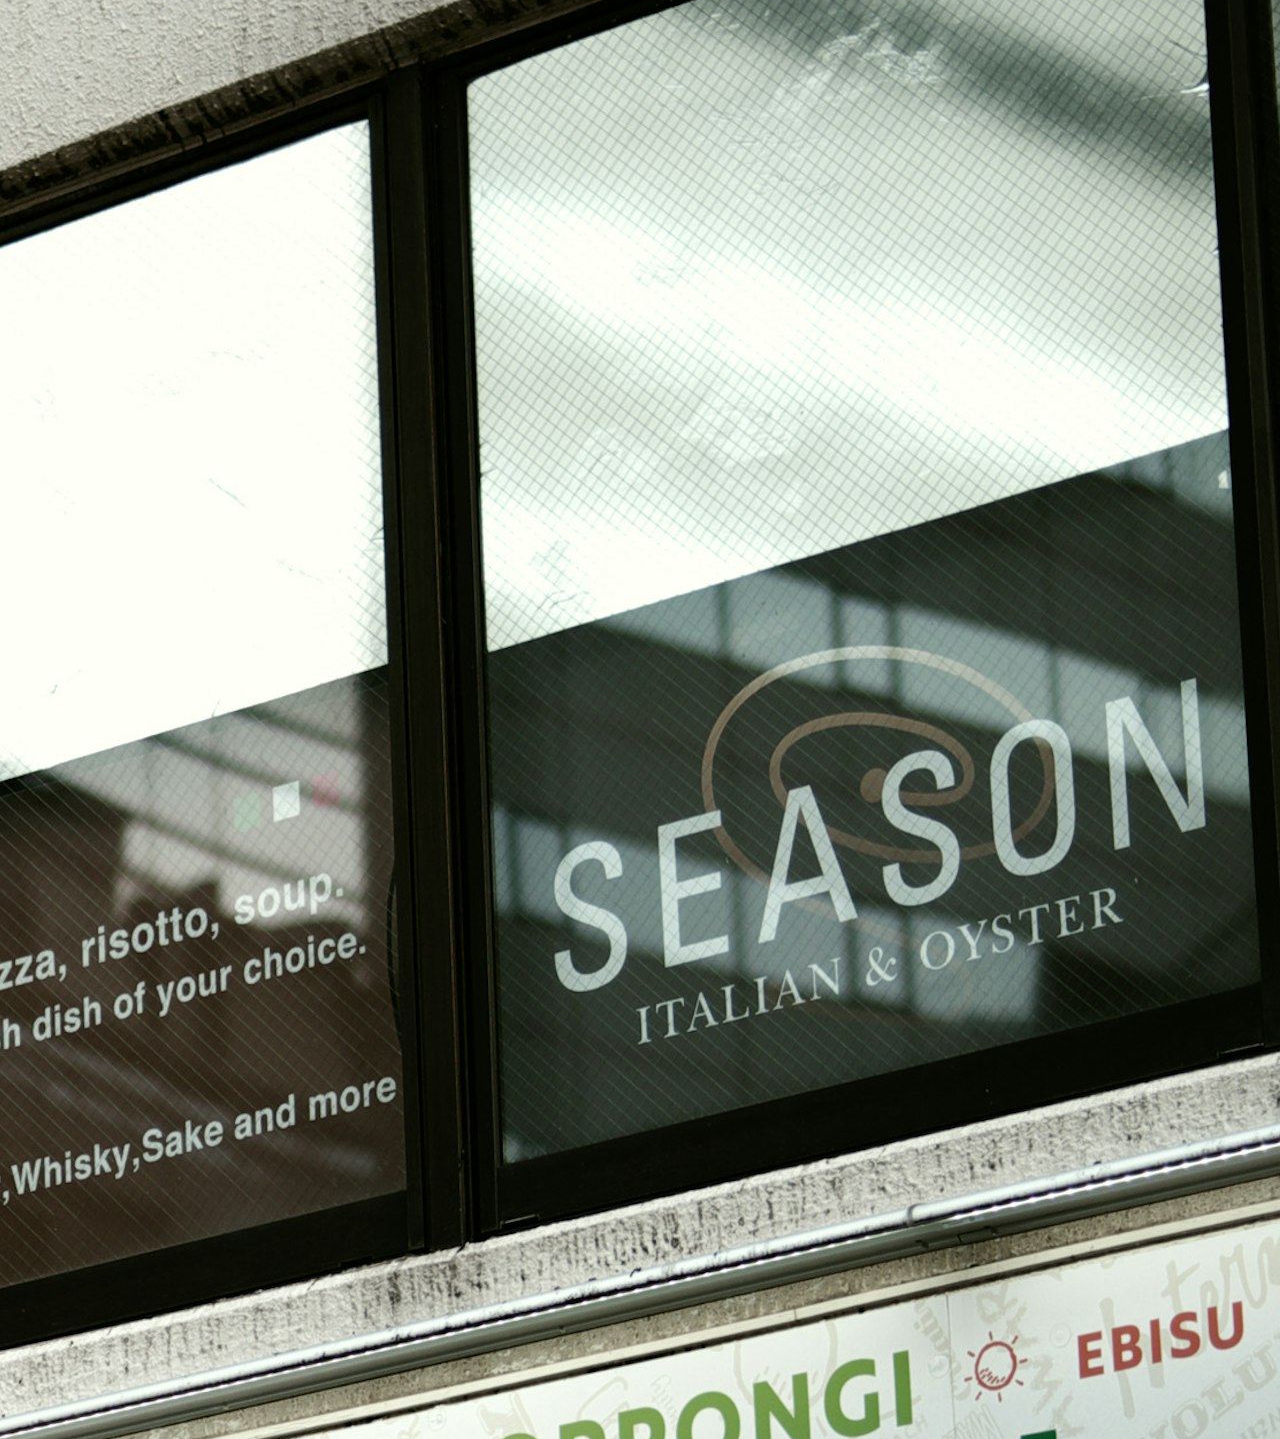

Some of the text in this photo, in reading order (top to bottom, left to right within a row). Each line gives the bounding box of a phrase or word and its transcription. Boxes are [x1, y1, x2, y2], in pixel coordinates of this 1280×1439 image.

[553, 677, 1208, 994] SEASON
[81, 906, 221, 969] risotto,
[233, 870, 346, 925] soup.
[636, 887, 1126, 1046] ITALIAN & OYSTER
[32, 997, 102, 1042] dish
[113, 986, 147, 1022] of
[156, 964, 232, 1017] your
[243, 931, 368, 986] choice.
[233, 1095, 297, 1141] and
[308, 1073, 398, 1124] more
[1076, 1300, 1245, 1379] EBISU
